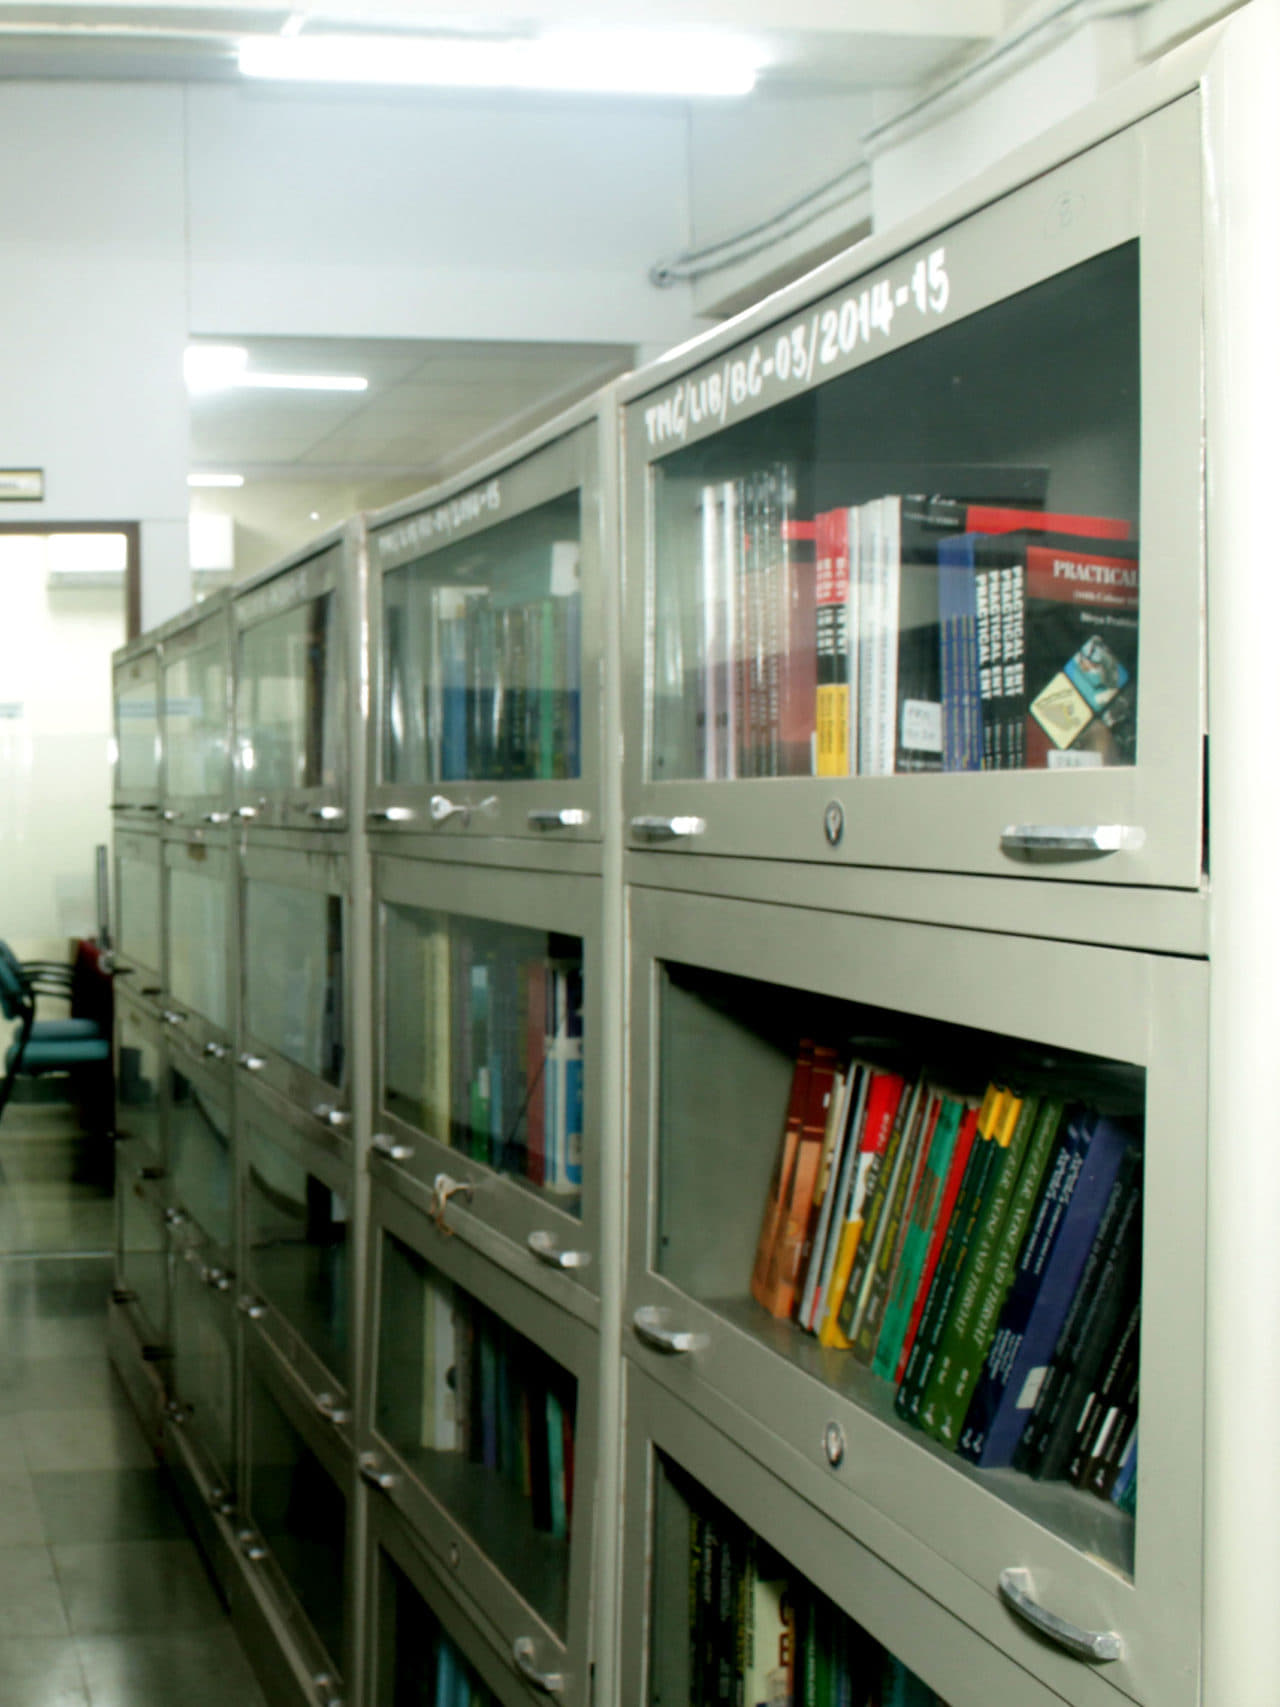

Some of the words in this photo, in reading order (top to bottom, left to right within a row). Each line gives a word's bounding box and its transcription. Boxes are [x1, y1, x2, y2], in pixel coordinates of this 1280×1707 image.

[976, 573, 990, 666] PRACTICAL
[988, 569, 1001, 664] PRACTICAL
[1000, 567, 1013, 664] PRACTICAL
[1012, 564, 1024, 661] PRACTICAL
